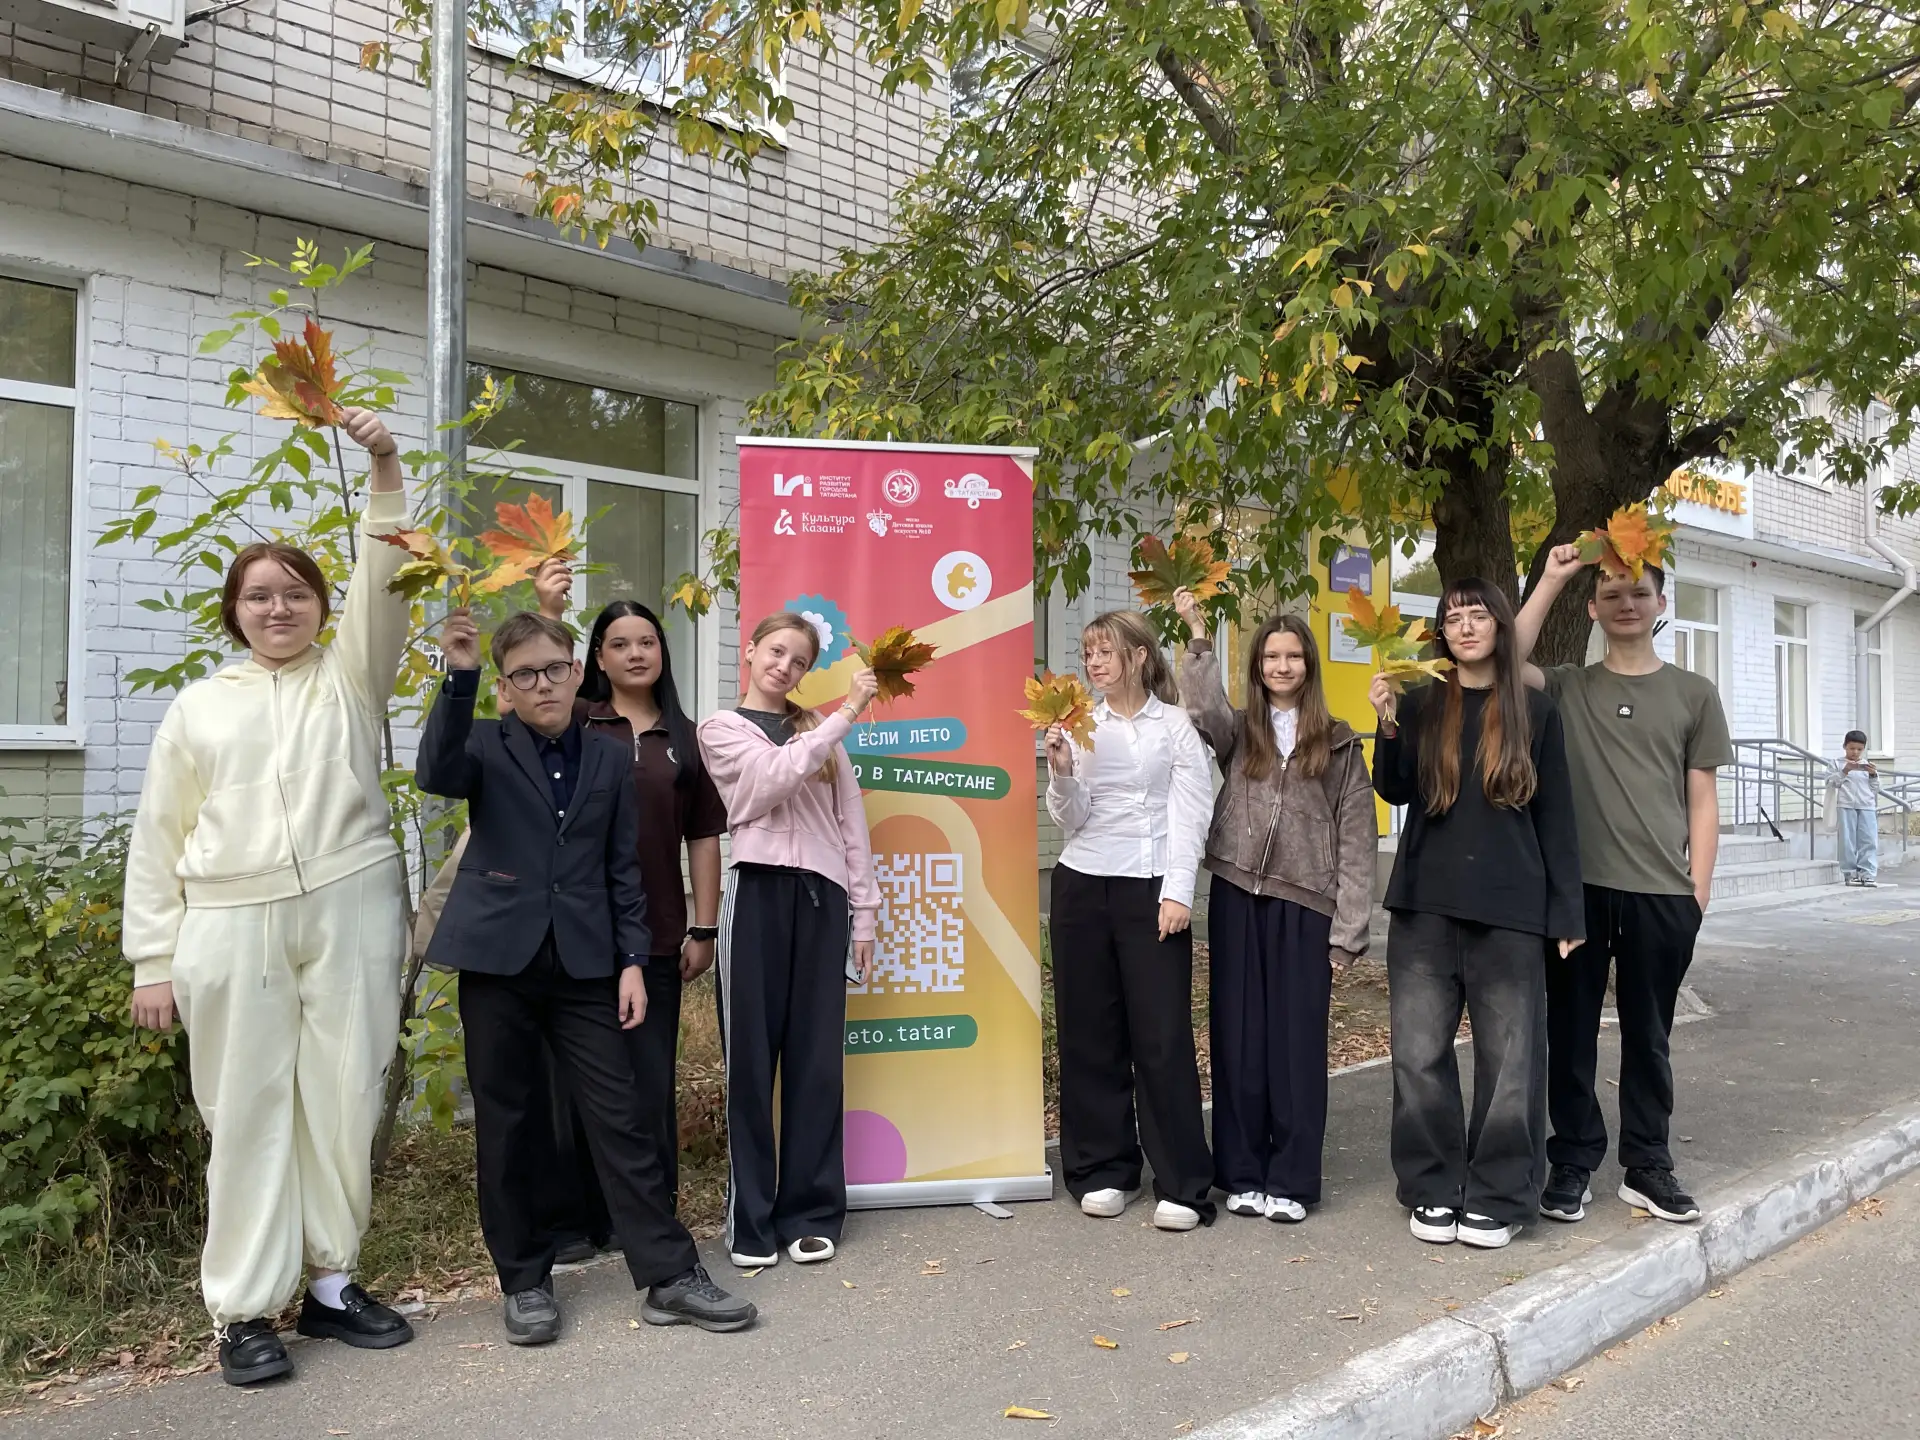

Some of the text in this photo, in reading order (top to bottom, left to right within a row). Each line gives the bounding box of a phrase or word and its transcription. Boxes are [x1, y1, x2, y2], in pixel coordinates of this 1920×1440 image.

[802, 512, 856, 526] Культура
[802, 522, 844, 533] Казани
[858, 727, 951, 747] ЕСЛИ ЛЕТО
[852, 765, 996, 791] О В ТАТАРСТАНЕ
[844, 1025, 956, 1045] eto.tatar
